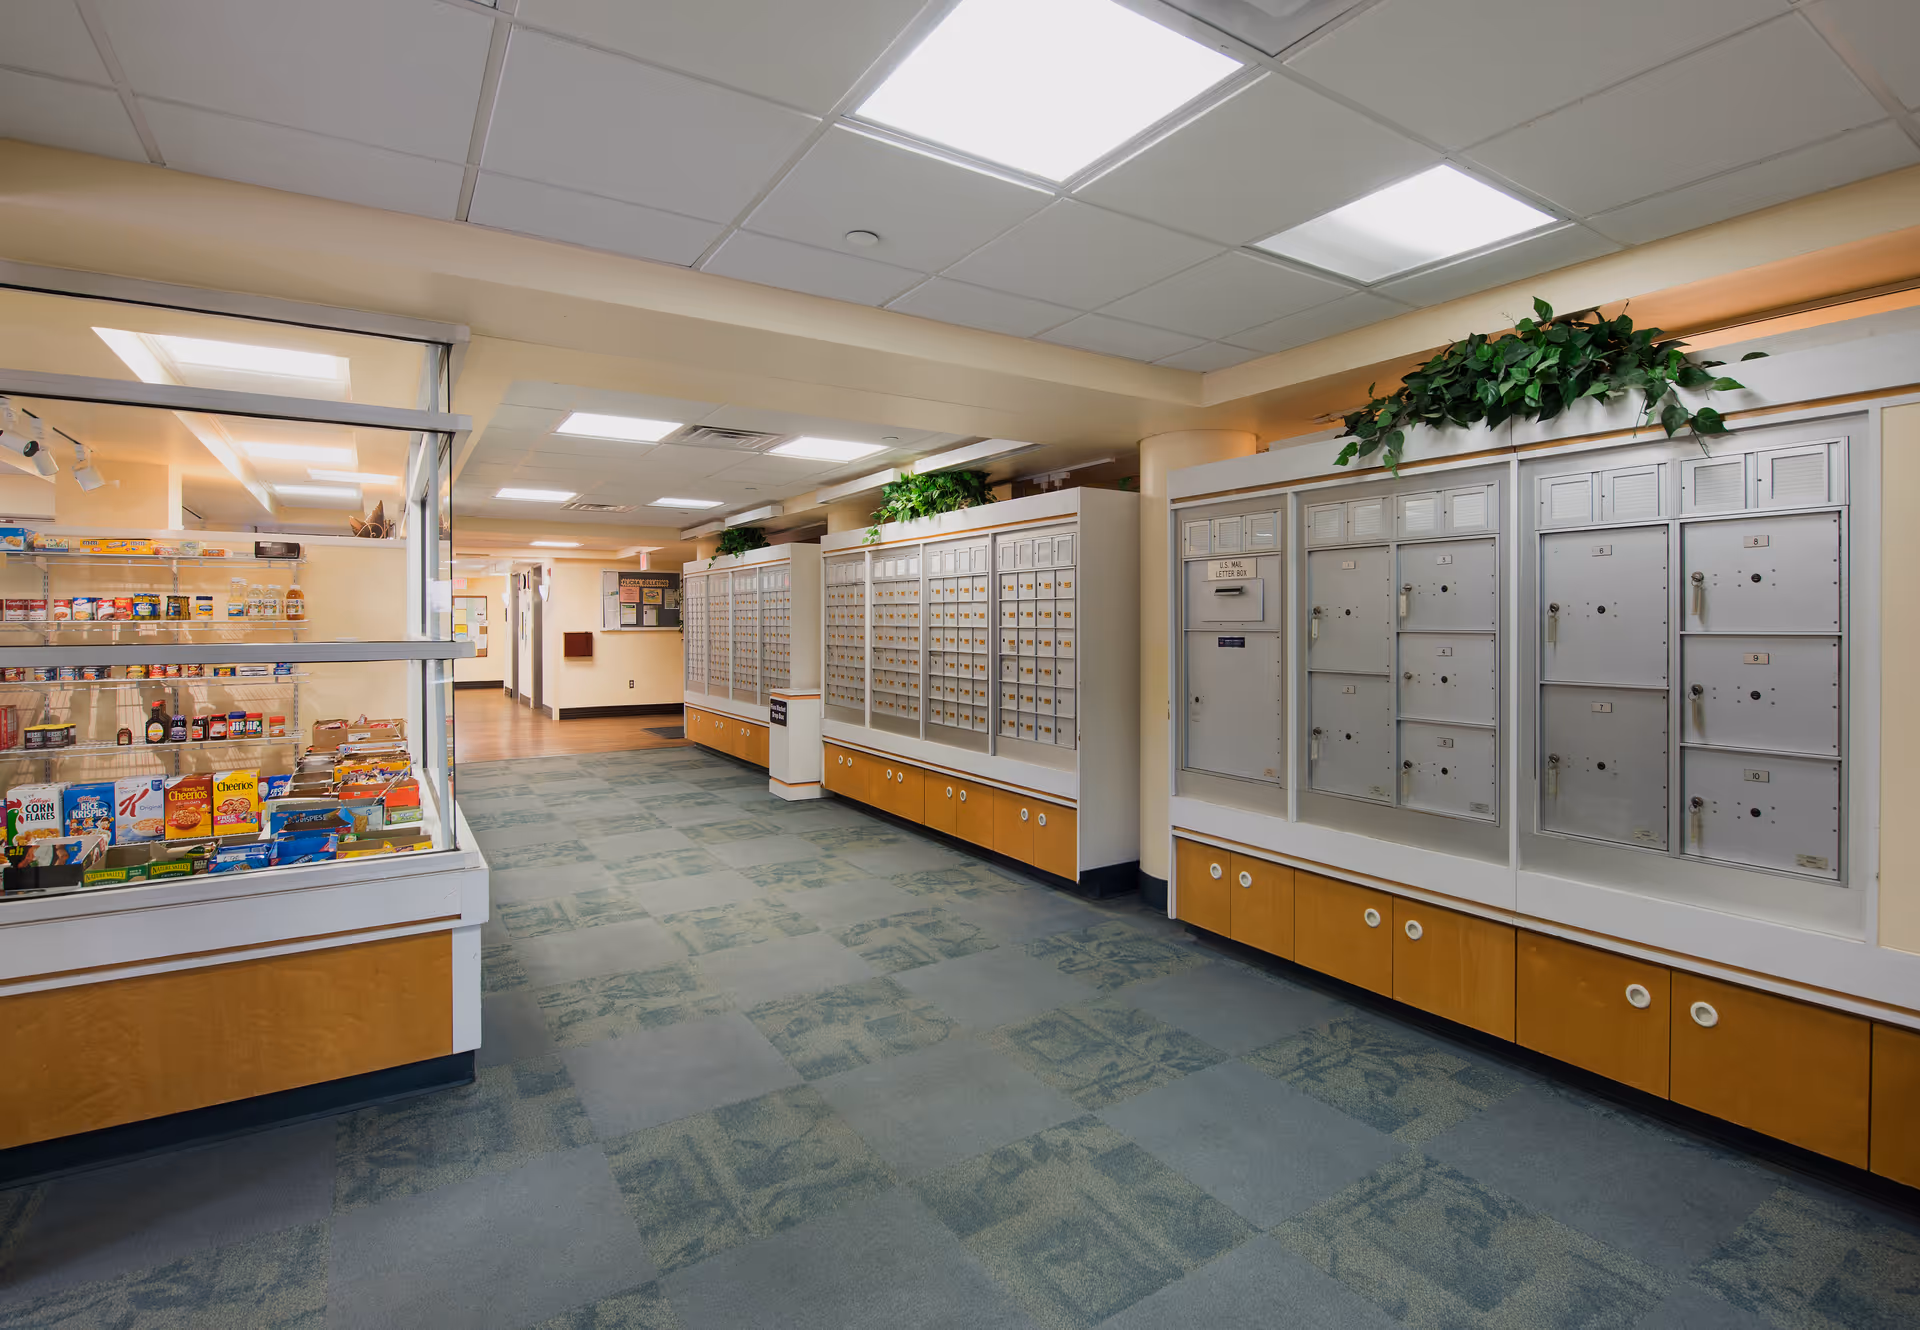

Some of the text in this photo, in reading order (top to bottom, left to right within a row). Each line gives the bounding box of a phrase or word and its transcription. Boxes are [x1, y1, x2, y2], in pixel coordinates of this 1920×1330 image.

[1219, 560, 1243, 569] U.S. MAIL
[1215, 569, 1248, 578] LETTER BOX
[1752, 772, 1760, 780] 10
[217, 781, 254, 792] Cheerios
[169, 791, 208, 801] Cheerios
[80, 802, 99, 811] RICE
[119, 788, 149, 817] K
[140, 803, 163, 811] Original
[25, 802, 55, 813] CORN
[25, 812, 56, 821] FLAKES
[72, 807, 108, 819] KRISPIES
